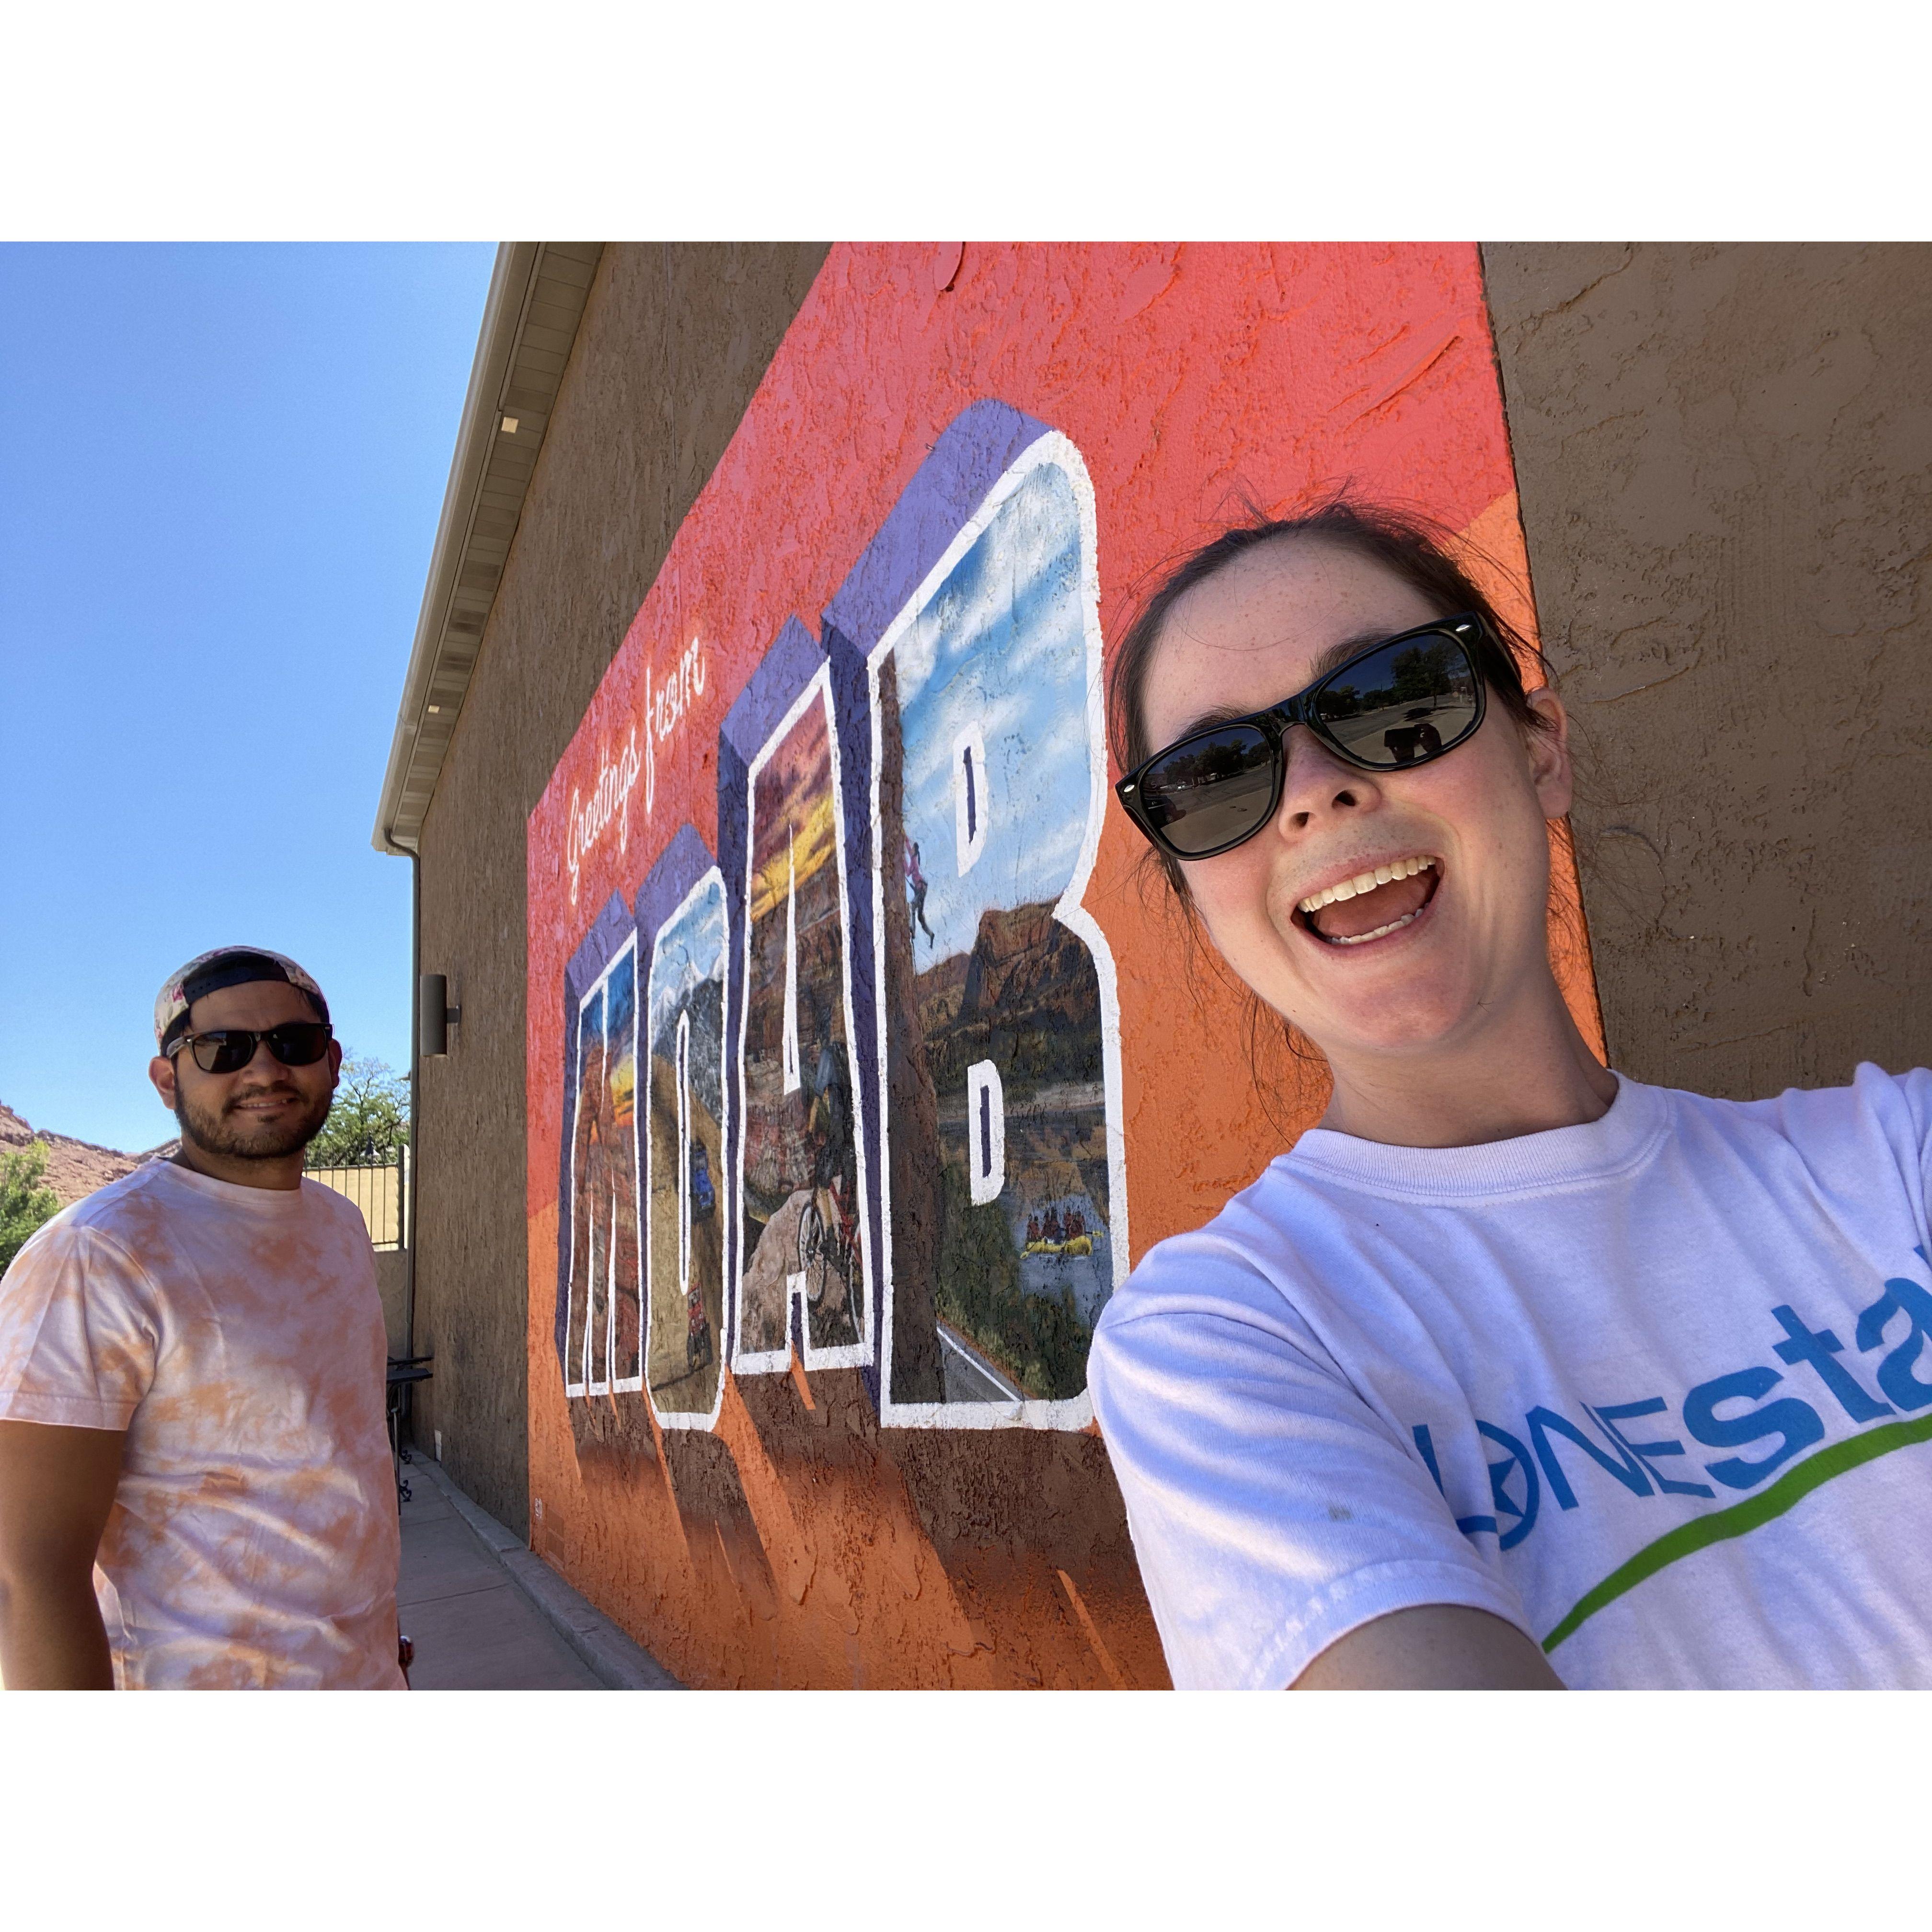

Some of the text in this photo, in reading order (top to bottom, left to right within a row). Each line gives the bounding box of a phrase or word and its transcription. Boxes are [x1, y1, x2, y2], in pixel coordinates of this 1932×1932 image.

[562, 427, 1129, 1432] MOAB
[567, 636, 705, 906] Greetings from
